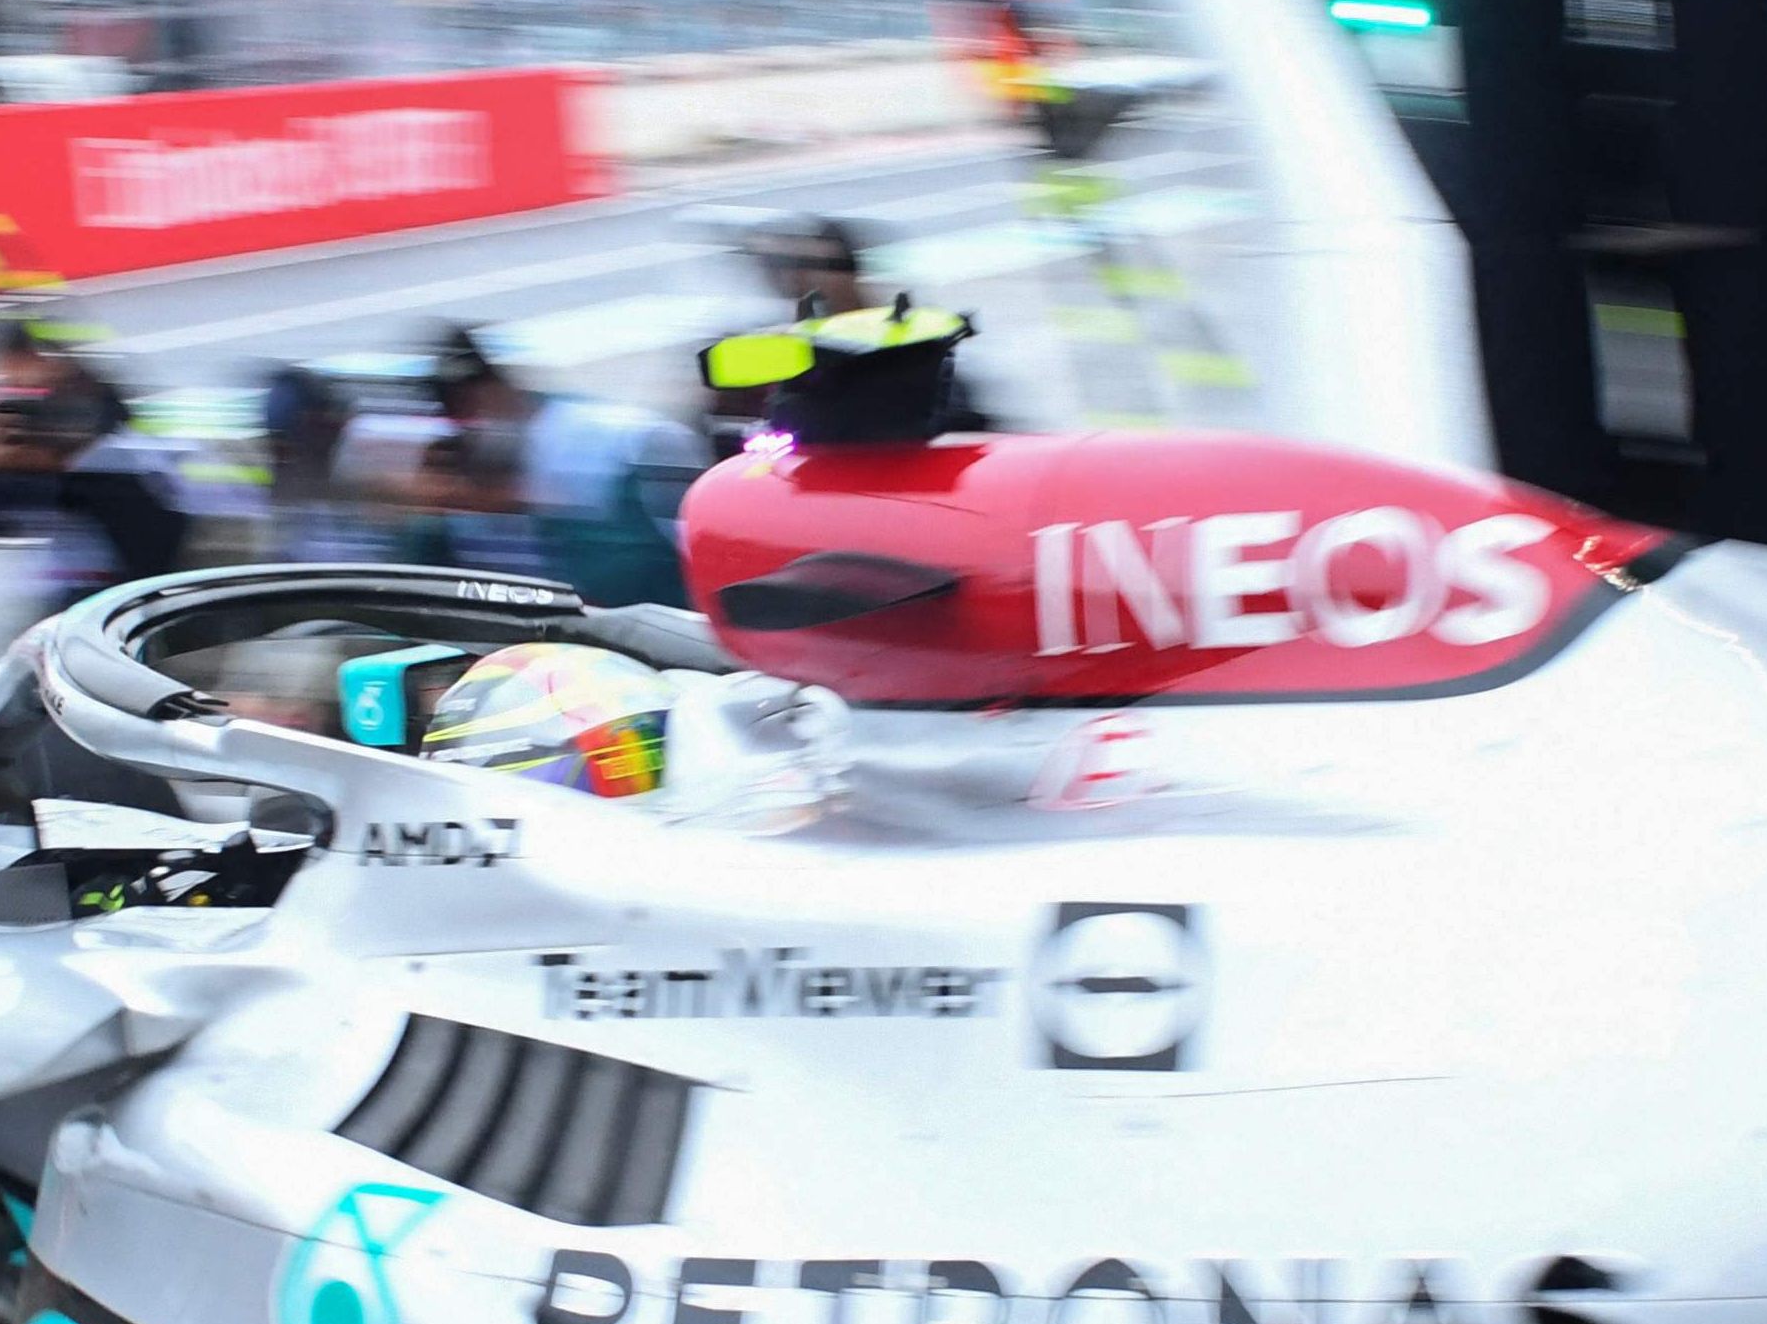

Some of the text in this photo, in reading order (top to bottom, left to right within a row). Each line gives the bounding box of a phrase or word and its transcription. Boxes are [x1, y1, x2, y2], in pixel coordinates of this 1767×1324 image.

[457, 580, 554, 605] INEOS
[1030, 505, 1558, 657] INEOS
[532, 945, 1009, 1019] TeamViewer
